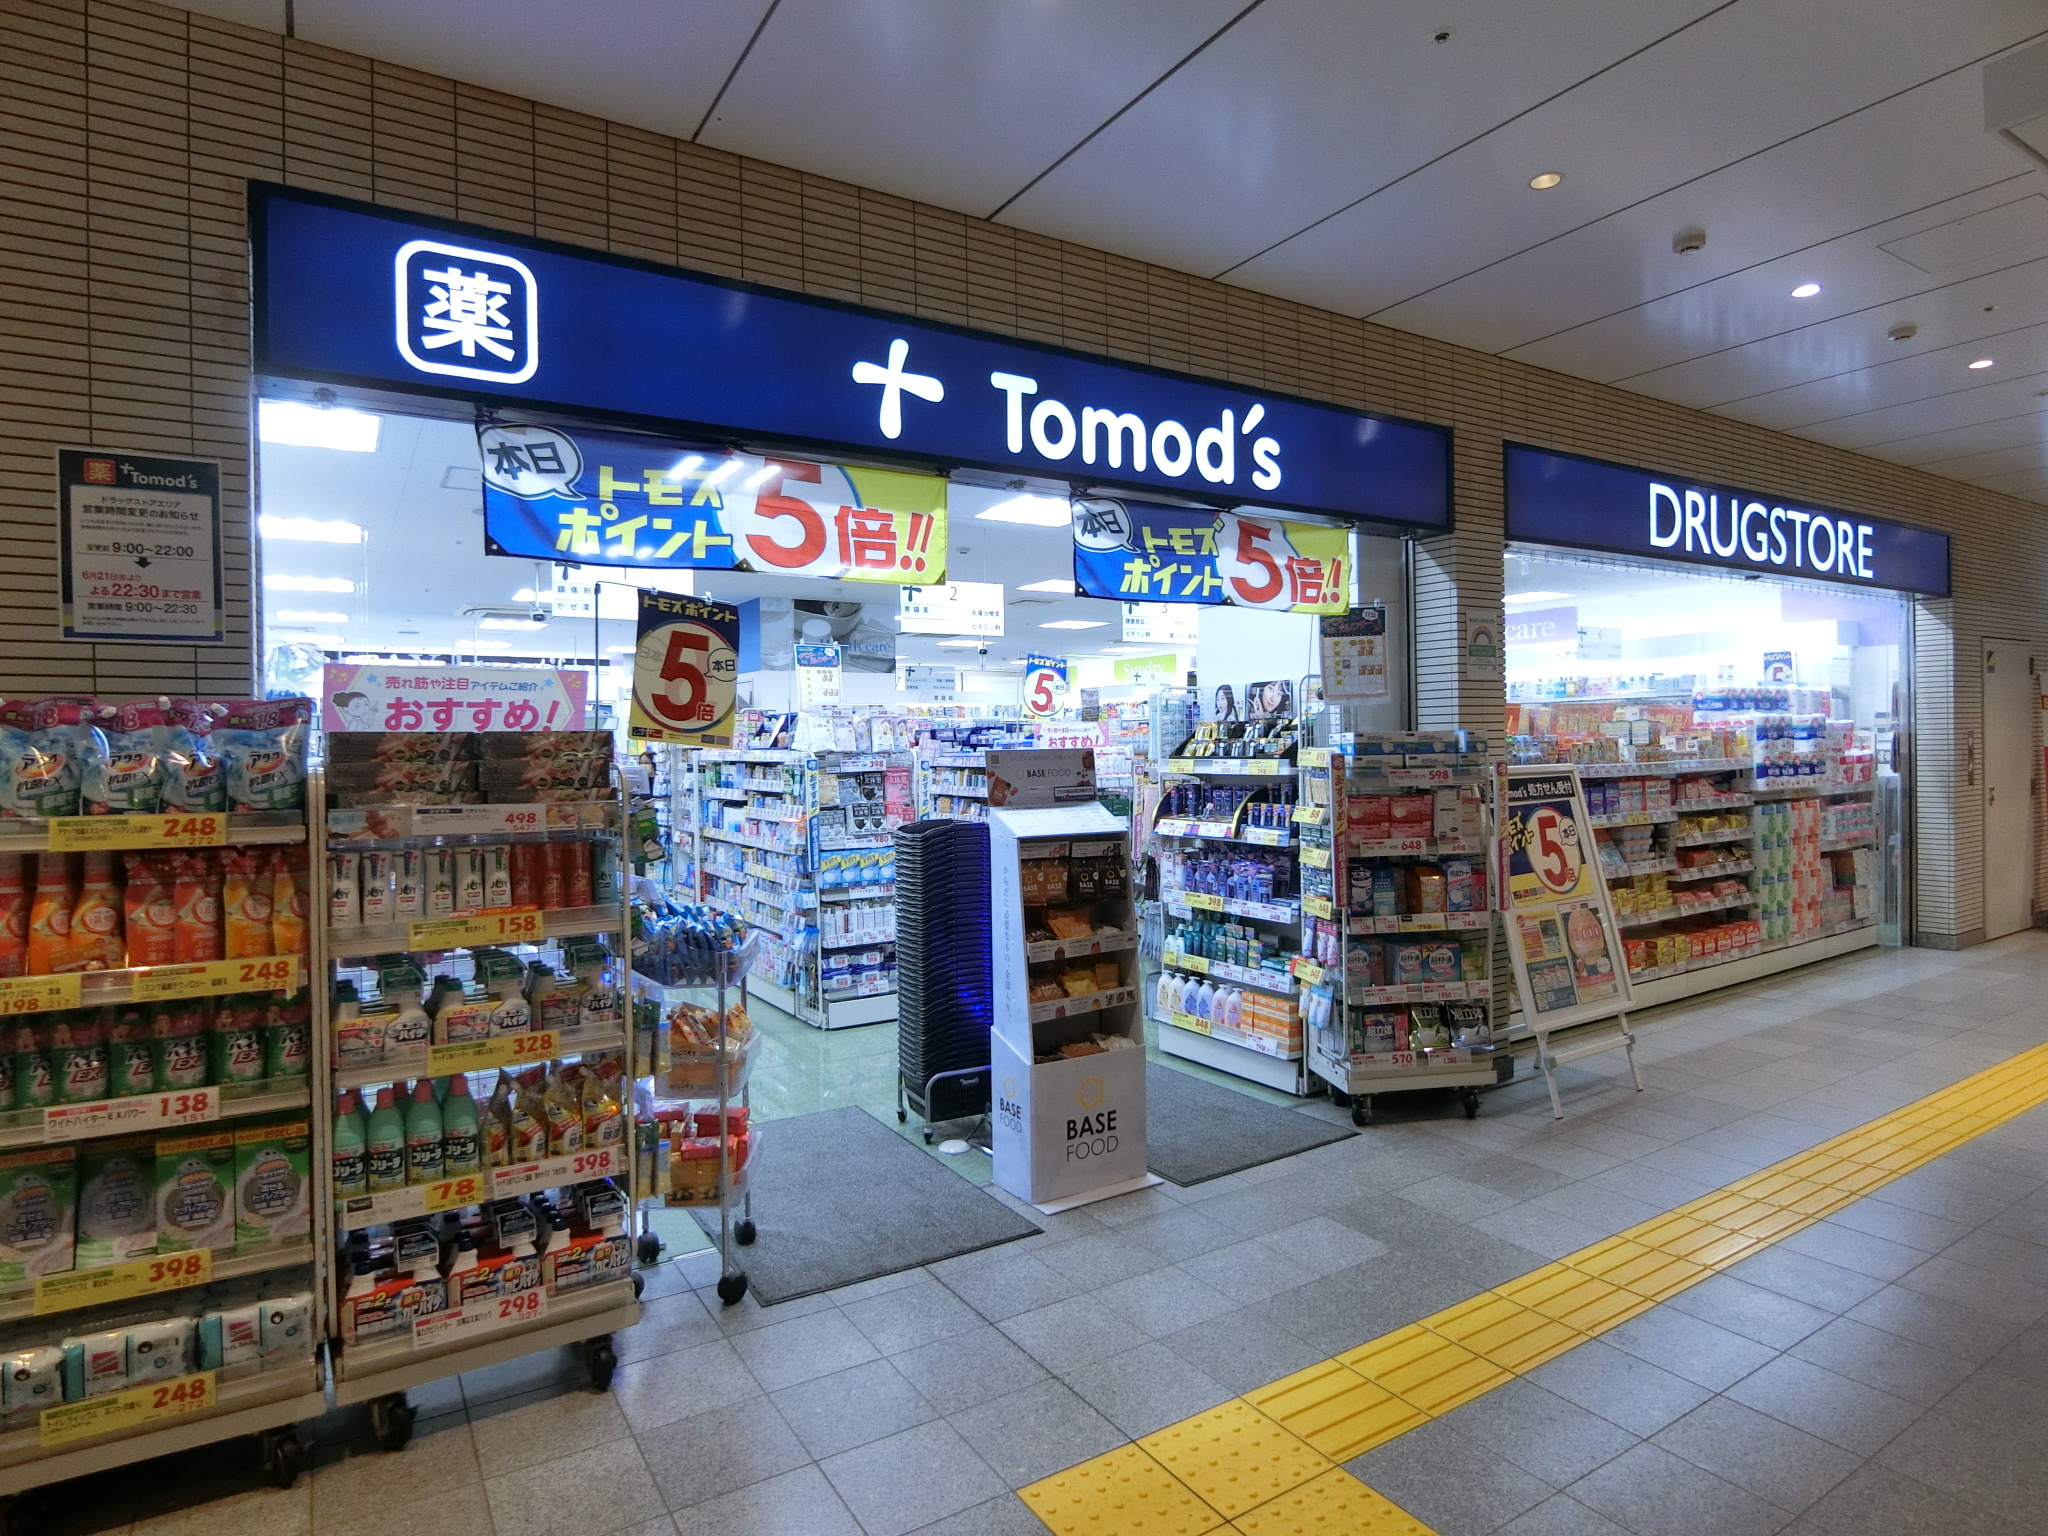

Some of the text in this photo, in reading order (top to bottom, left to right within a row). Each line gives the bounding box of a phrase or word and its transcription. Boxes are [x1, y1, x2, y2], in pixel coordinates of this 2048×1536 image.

[421, 267, 516, 362] 薬
[990, 371, 1283, 491] Tomod's
[487, 441, 566, 482] 本日
[89, 462, 199, 490] 薬 Tomod's
[556, 506, 733, 560] ポイント
[1076, 514, 1123, 539] 本日
[1649, 482, 1875, 579] DRUGSTORE
[1141, 519, 1226, 557] トモズ
[1119, 553, 1225, 598] ポイント
[949, 586, 958, 601] 2
[643, 595, 738, 623] トモズポイント
[1504, 619, 1557, 642] care
[865, 642, 891, 653] care
[712, 659, 736, 673] 本日
[1028, 657, 1067, 669] トモズポイント
[385, 675, 539, 692] 売れ筋や注目アイテムご紹介
[384, 697, 560, 732] おすすめ!
[869, 760, 884, 768] 398
[1026, 768, 1072, 778] BASE FOOD
[1428, 770, 1449, 781] 598
[1508, 780, 1573, 798] mod's 処方せん受付
[163, 817, 217, 837] 248
[504, 812, 537, 824] 498
[873, 835, 889, 843] 980
[1561, 824, 1577, 839] 本日
[188, 837, 214, 846] 272
[1401, 841, 1422, 851] 648
[398, 884, 418, 895] JOY
[464, 880, 483, 891] JOY
[489, 879, 509, 889] JOY
[1079, 881, 1094, 889] BASE
[1104, 878, 1120, 886] BASE
[365, 886, 385, 898] JOY
[1207, 897, 1221, 907] 398
[498, 915, 537, 934] 158
[239, 960, 290, 983] 248
[263, 980, 288, 989] 272
[3, 998, 38, 1013] 198
[1195, 1018, 1209, 1030] 848
[513, 1033, 554, 1055] 328
[1392, 1054, 1413, 1065] 570
[160, 1092, 209, 1118] 138
[999, 1097, 1022, 1120] BASE
[999, 1113, 1023, 1134] FOOD
[1066, 1110, 1117, 1141] BASE
[1066, 1135, 1119, 1162] FOOD
[573, 1150, 612, 1174] 398
[432, 1178, 476, 1200] 78
[459, 1194, 475, 1204] 85
[149, 1254, 202, 1283] 398
[498, 1291, 540, 1318] 298
[152, 1378, 207, 1409] 248
[178, 1399, 205, 1412] 272
